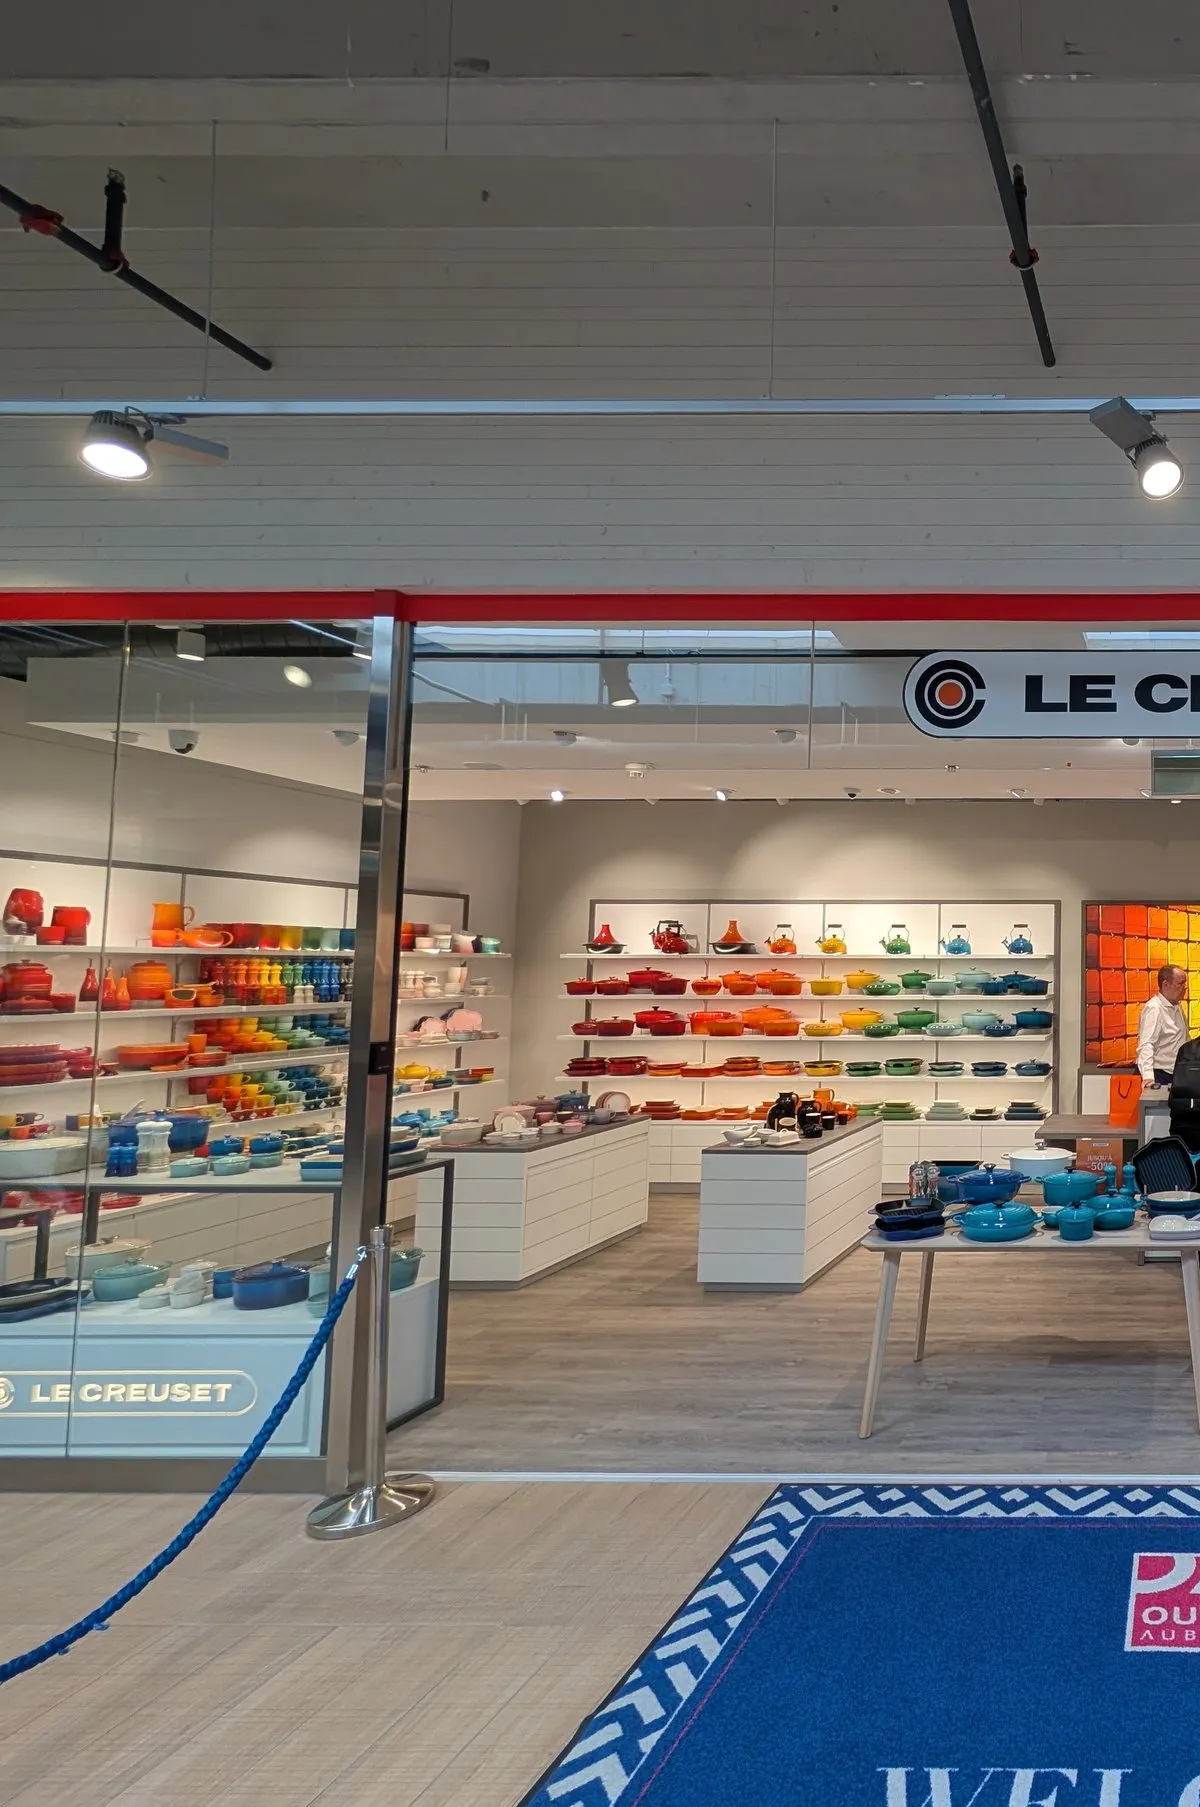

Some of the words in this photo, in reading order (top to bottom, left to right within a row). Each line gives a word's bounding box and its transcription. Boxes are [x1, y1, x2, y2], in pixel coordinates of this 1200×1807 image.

[1024, 674, 1118, 713] LE
[30, 1383, 72, 1403] LE
[79, 1383, 233, 1402] CREUSET
